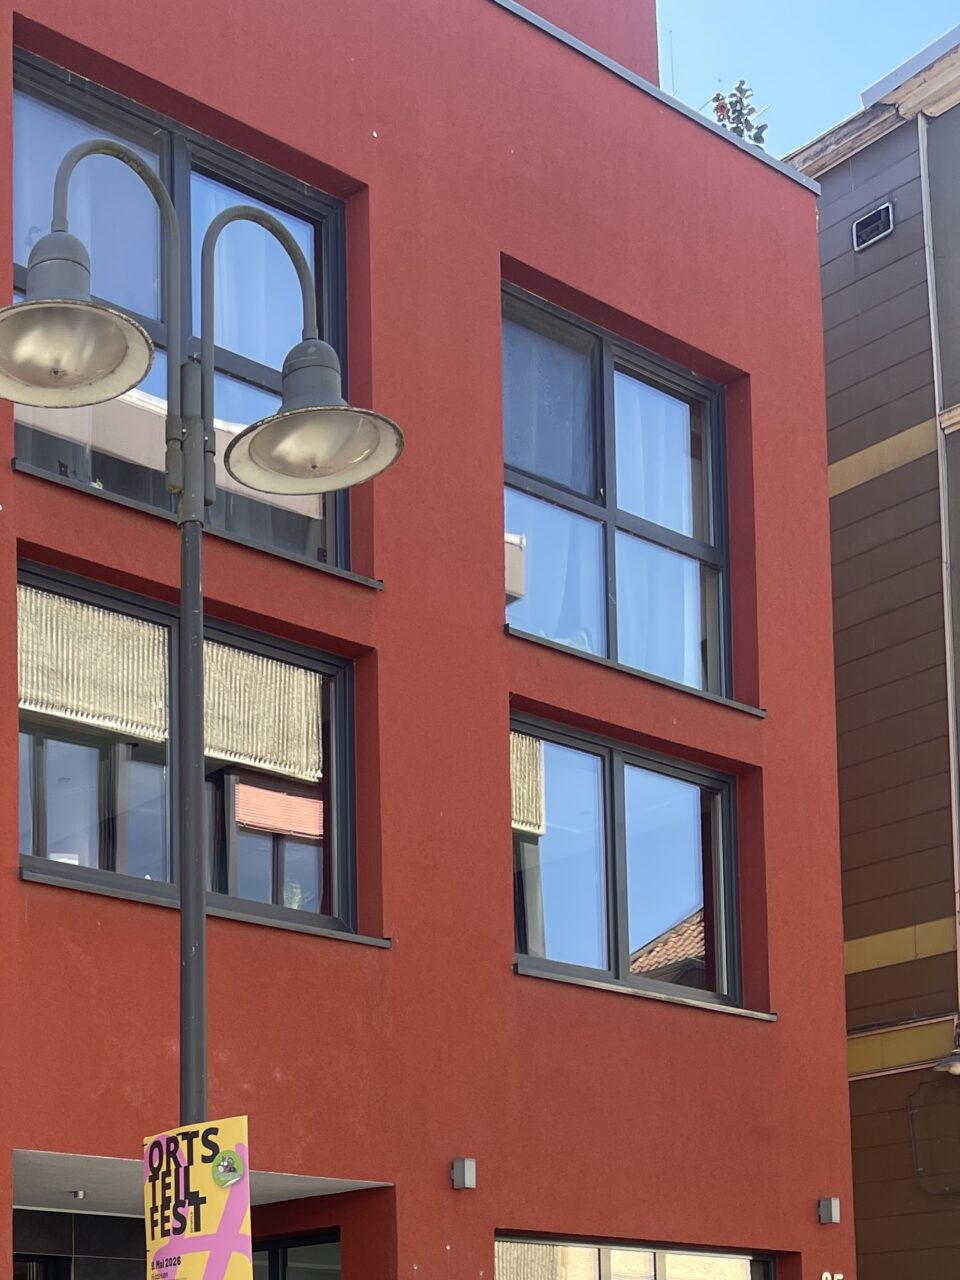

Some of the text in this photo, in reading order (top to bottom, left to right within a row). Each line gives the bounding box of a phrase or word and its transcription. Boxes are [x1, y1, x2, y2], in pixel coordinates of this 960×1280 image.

[149, 1127, 220, 1174] ORTS
[149, 1165, 200, 1208] TEIL
[150, 1196, 207, 1241] FEST
[165, 1256, 181, 1268] 2026
